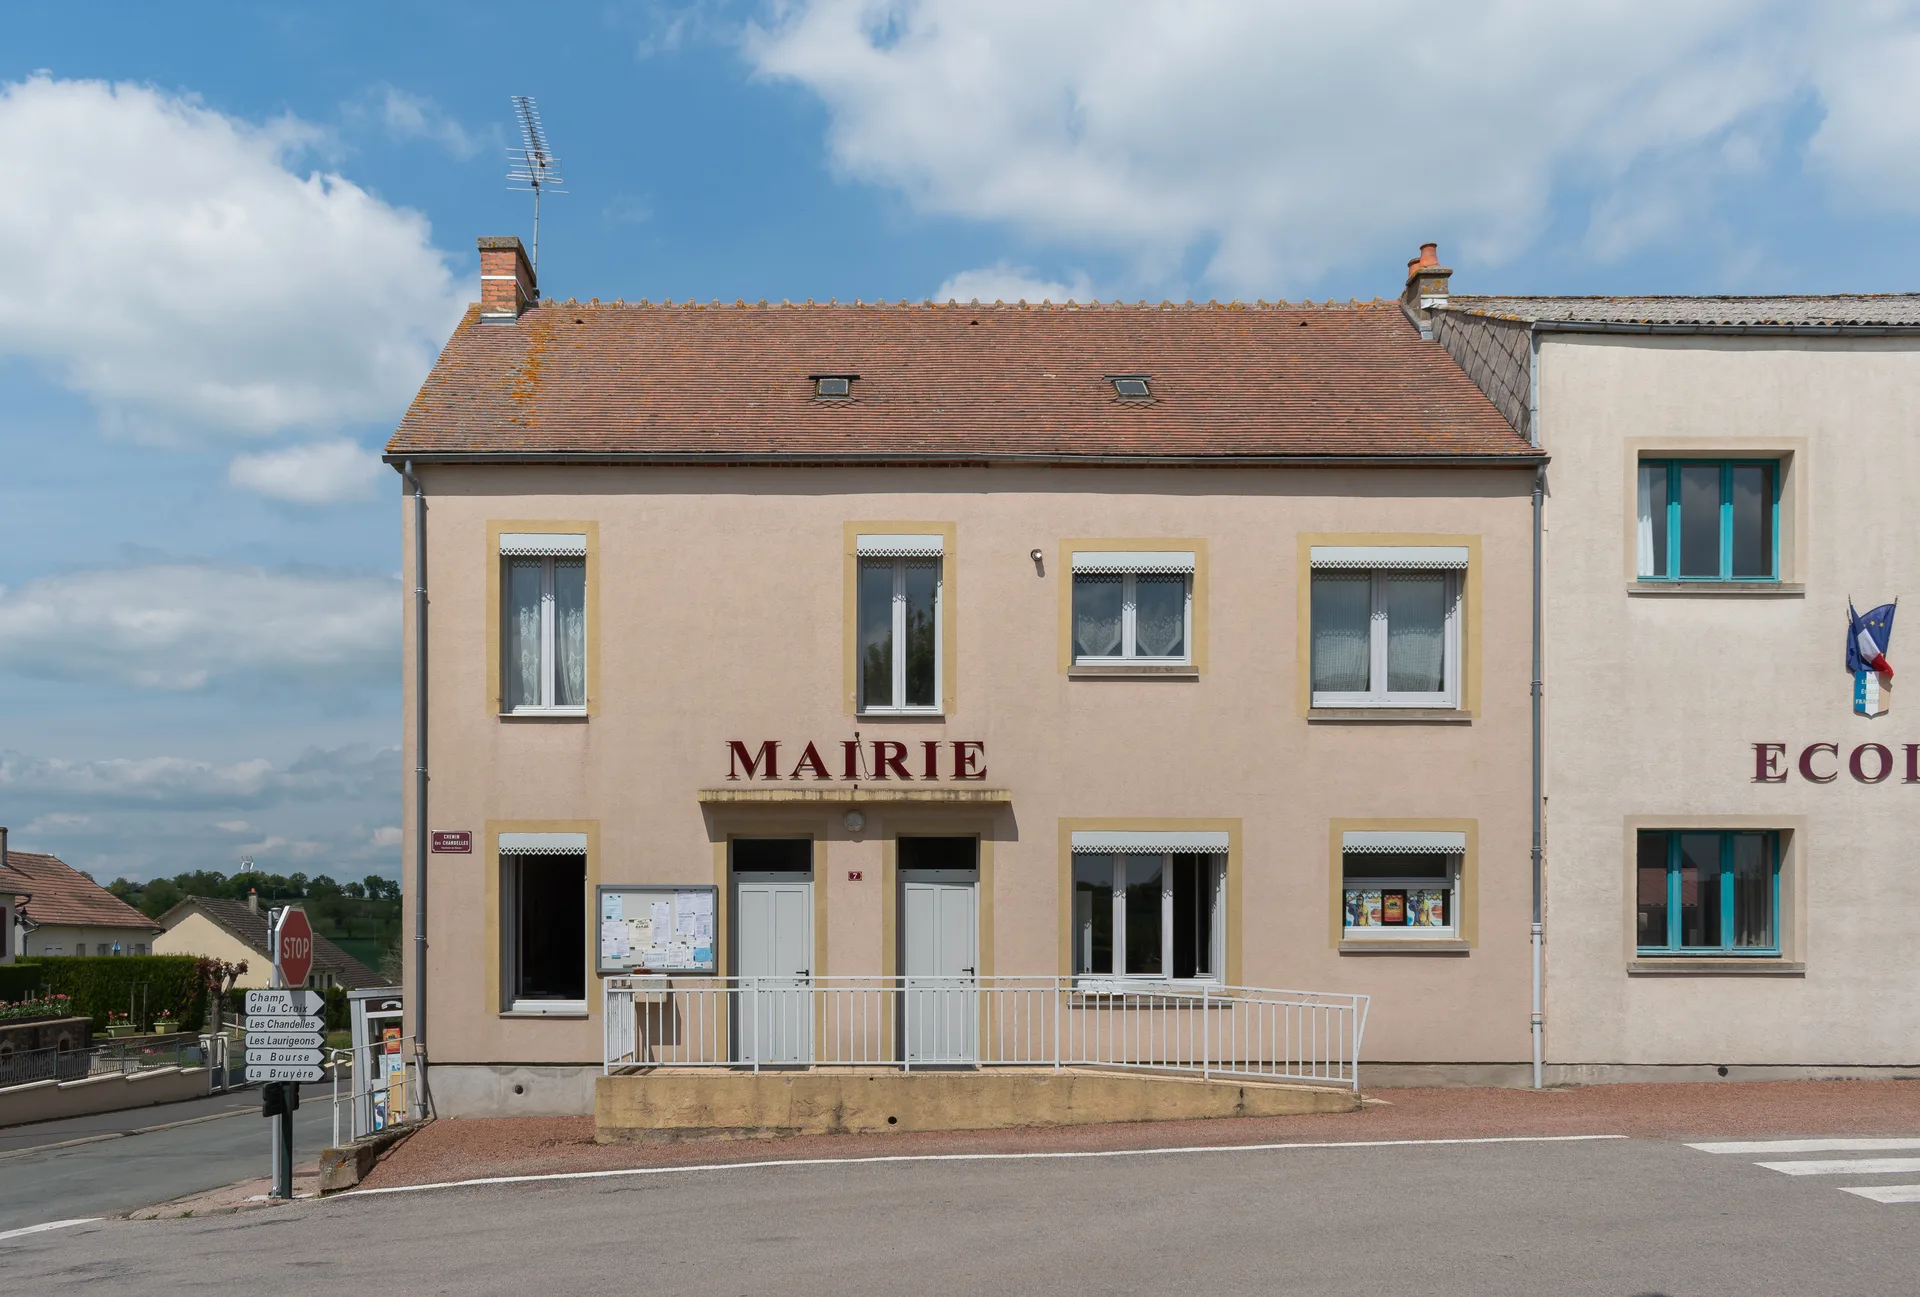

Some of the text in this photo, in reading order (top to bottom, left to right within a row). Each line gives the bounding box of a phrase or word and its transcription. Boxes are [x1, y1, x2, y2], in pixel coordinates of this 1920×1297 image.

[725, 740, 987, 780] MAIRIE
[283, 936, 310, 959] STOP
[250, 993, 285, 1004] Champ
[250, 1003, 309, 1013] de la Croix
[249, 1019, 316, 1029] Les Chandelles
[249, 1035, 316, 1047] Les Laurigeons
[249, 1052, 310, 1061] La Bourse
[249, 1068, 314, 1079] La Bruyère
